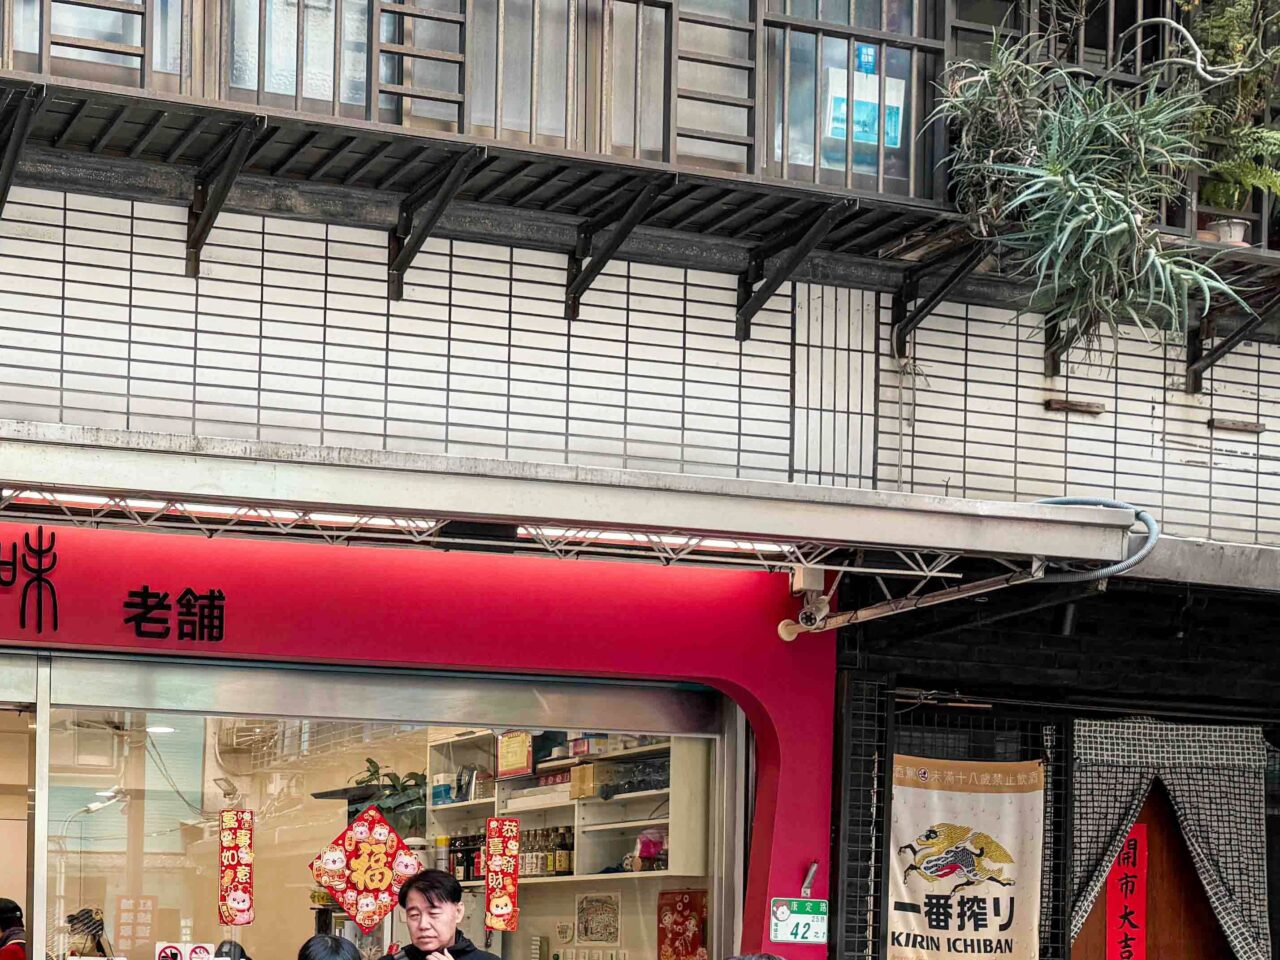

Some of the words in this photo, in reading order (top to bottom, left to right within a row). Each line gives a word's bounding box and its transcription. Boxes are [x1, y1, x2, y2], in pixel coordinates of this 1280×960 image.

[221, 810, 252, 883] 萬事如意
[350, 842, 393, 890] 福
[488, 820, 517, 889] 恭喜發財
[791, 901, 827, 912] 康定路
[893, 893, 1016, 932] 一番搾り
[790, 922, 811, 939] 42
[891, 931, 941, 951] KIRIN
[947, 937, 1013, 954] ICHIBAN
